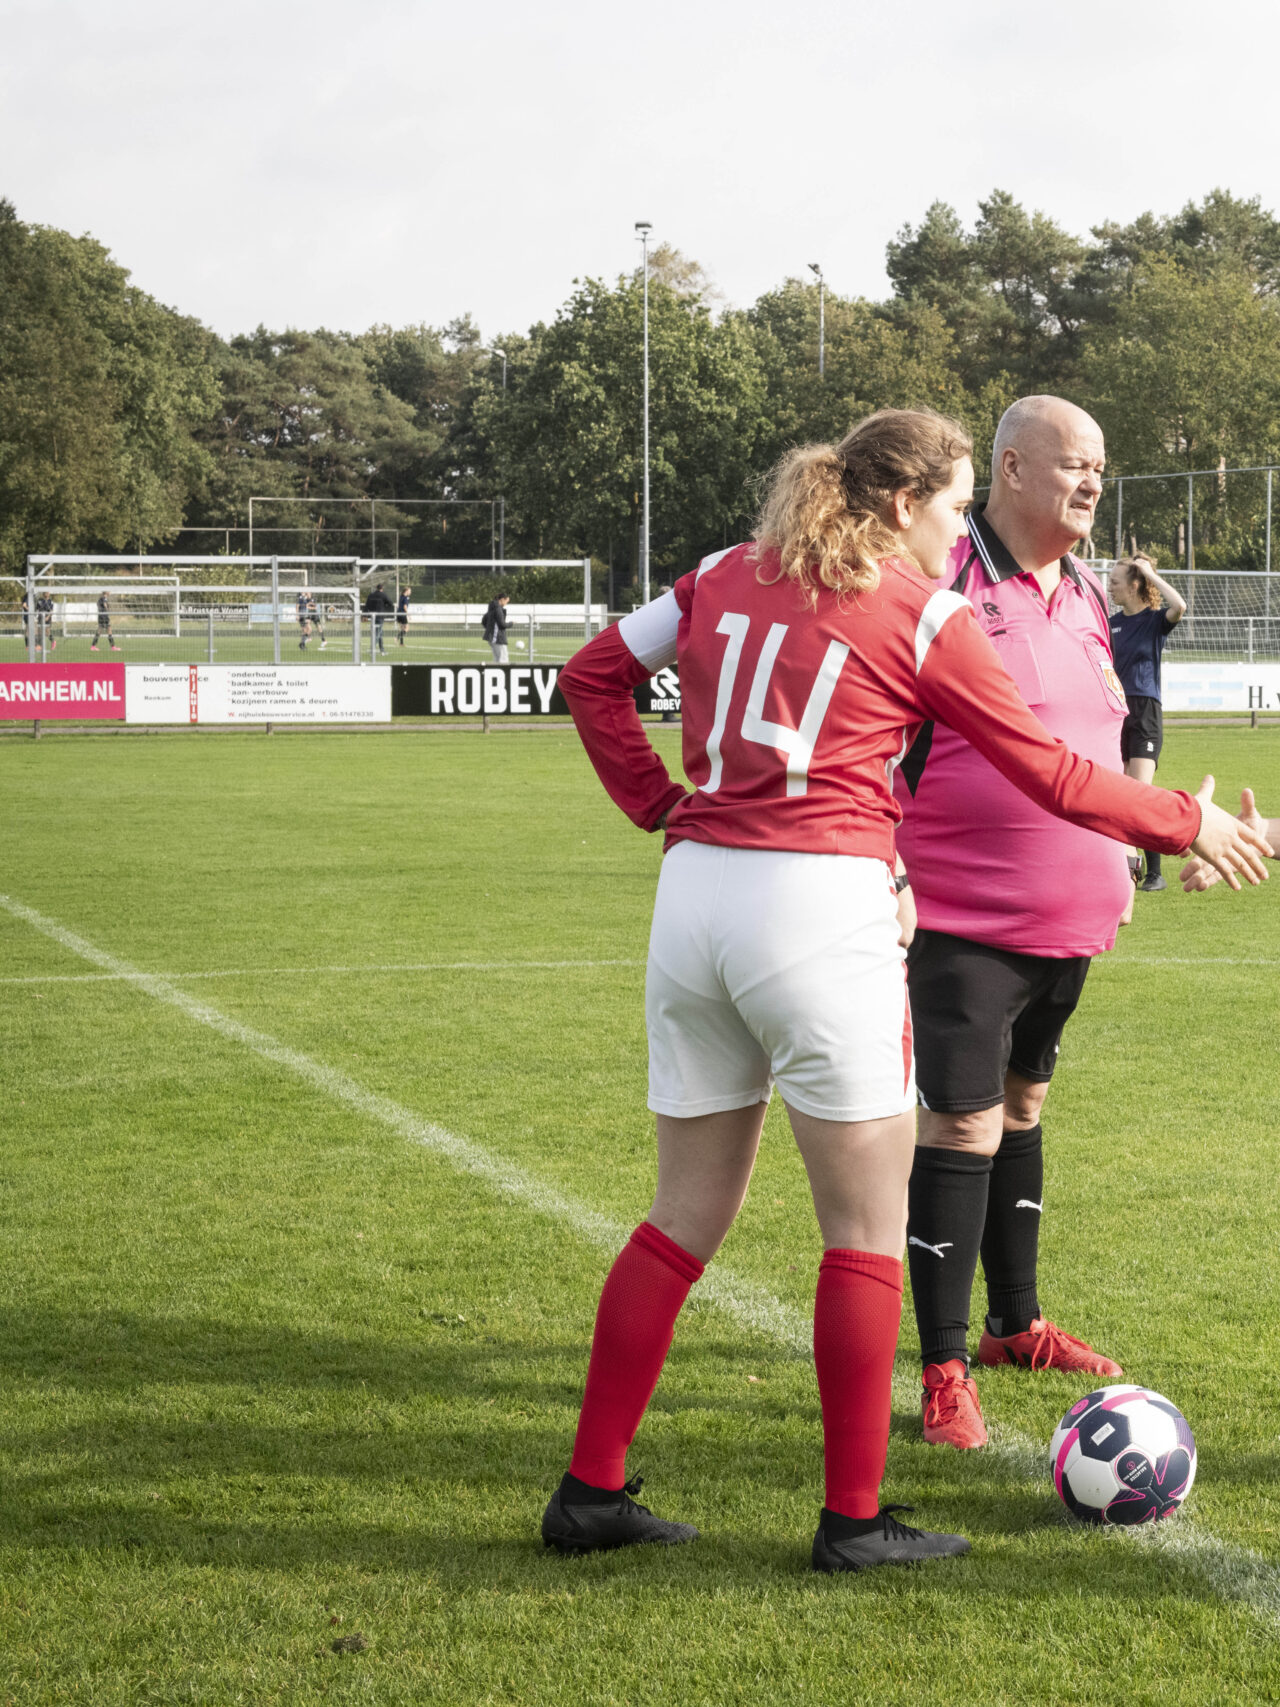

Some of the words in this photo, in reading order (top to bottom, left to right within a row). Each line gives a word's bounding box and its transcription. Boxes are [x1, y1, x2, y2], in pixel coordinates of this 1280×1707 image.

[231, 697, 267, 706] kozijnen
[430, 668, 557, 713] ROBEY
[1248, 685, 1271, 709] H.
[650, 699, 681, 711] ROBEY
[697, 611, 850, 798] 14
